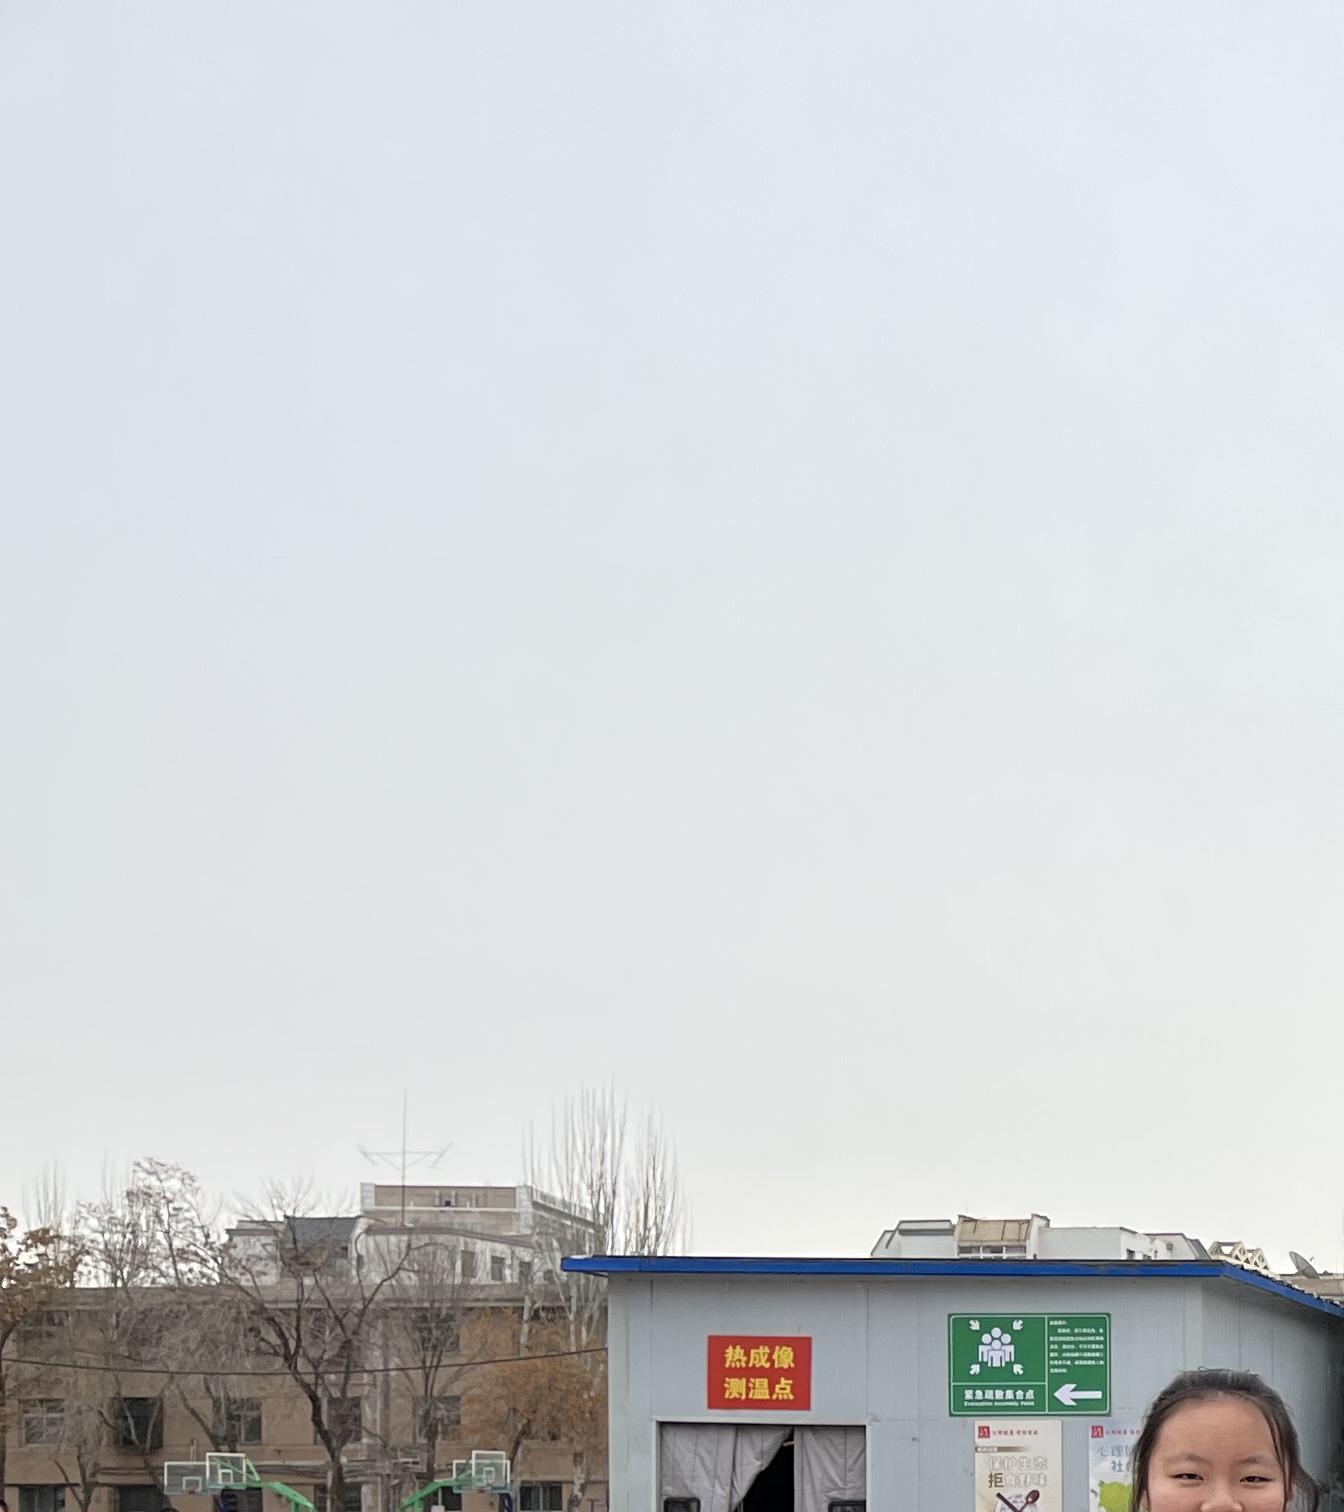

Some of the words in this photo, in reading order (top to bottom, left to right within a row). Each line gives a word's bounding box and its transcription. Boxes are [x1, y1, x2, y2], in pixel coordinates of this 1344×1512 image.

[724, 1344, 795, 1369] 热成像
[724, 1376, 795, 1400] 测温点
[988, 1472, 1048, 1489] 拒食野味
